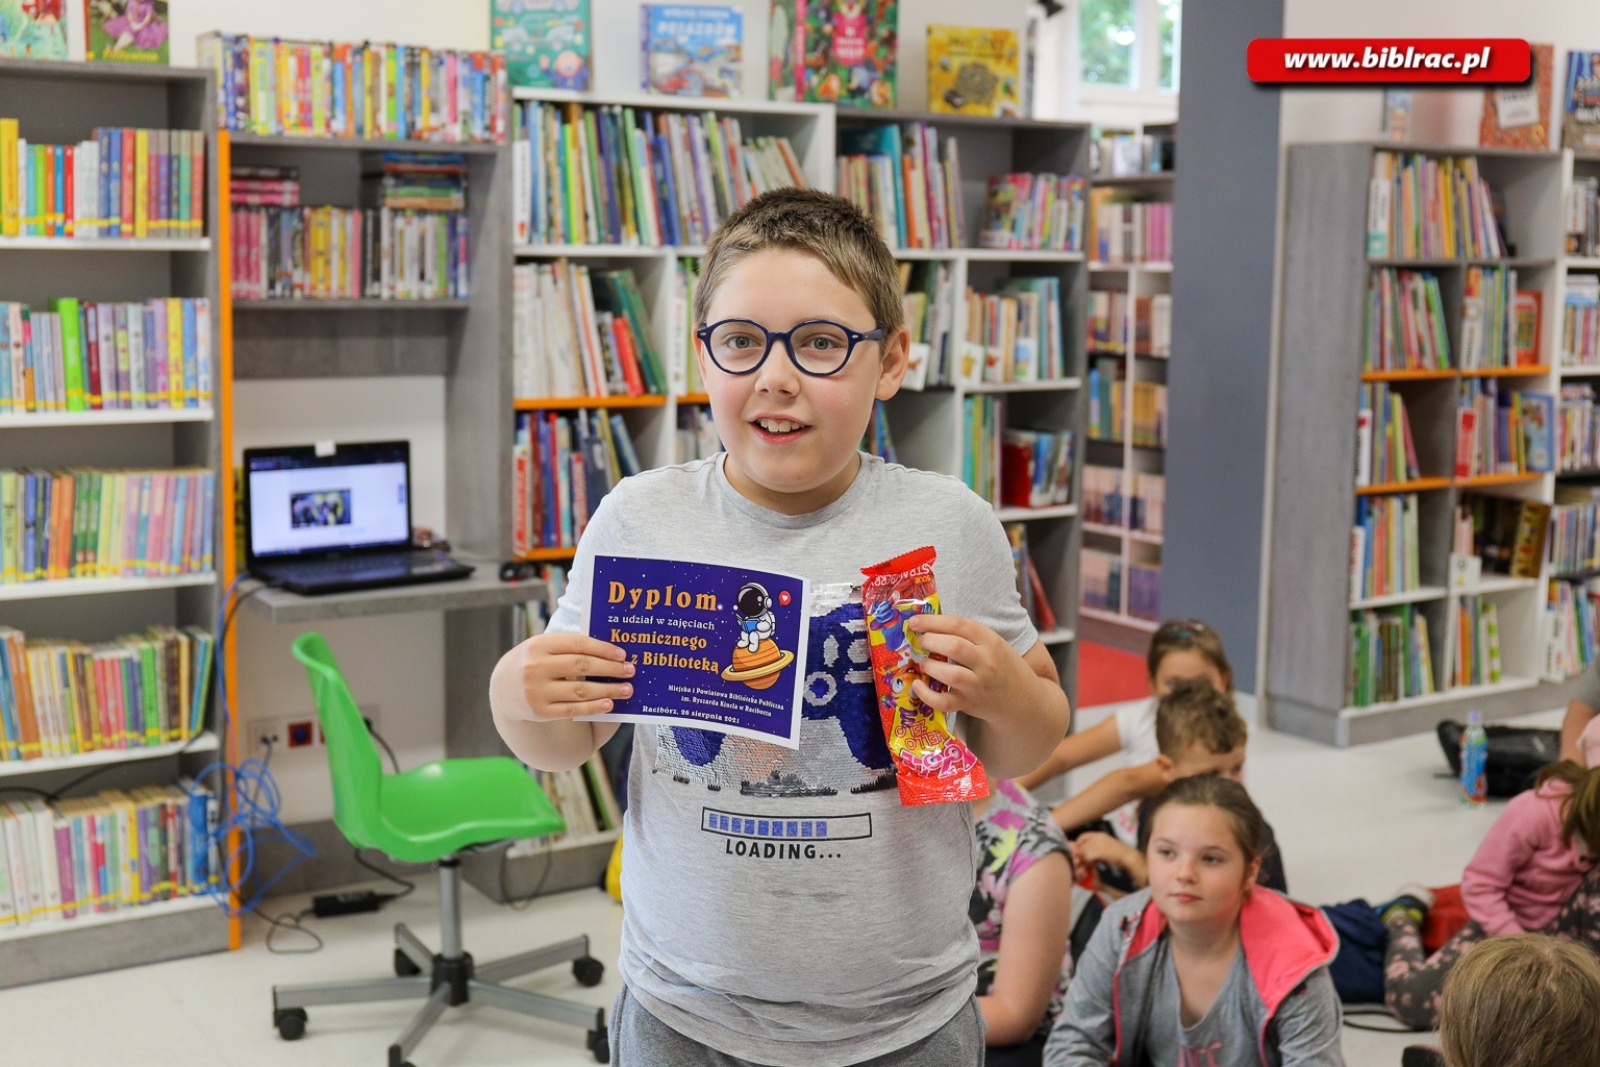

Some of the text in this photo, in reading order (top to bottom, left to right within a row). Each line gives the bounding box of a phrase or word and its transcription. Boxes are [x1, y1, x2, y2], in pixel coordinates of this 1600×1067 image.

[914, 575, 931, 585] SOUR
[608, 581, 717, 611] Dyplom
[608, 615, 619, 623] za
[622, 615, 654, 625] udział
[667, 618, 715, 630] zajęciach
[611, 629, 707, 651] Kosmicznego
[631, 651, 719, 674] z Biblioteką
[668, 684, 692, 694] Miejska
[696, 687, 728, 699] Powiatowa
[729, 693, 758, 705] Biblioteka
[758, 698, 784, 710] Publiczna
[692, 696, 719, 707] Ryszarda
[691, 710, 722, 721] sierpnia
[724, 715, 740, 724] 2021
[905, 730, 947, 750] HELLO
[726, 839, 842, 859] LOADING...
